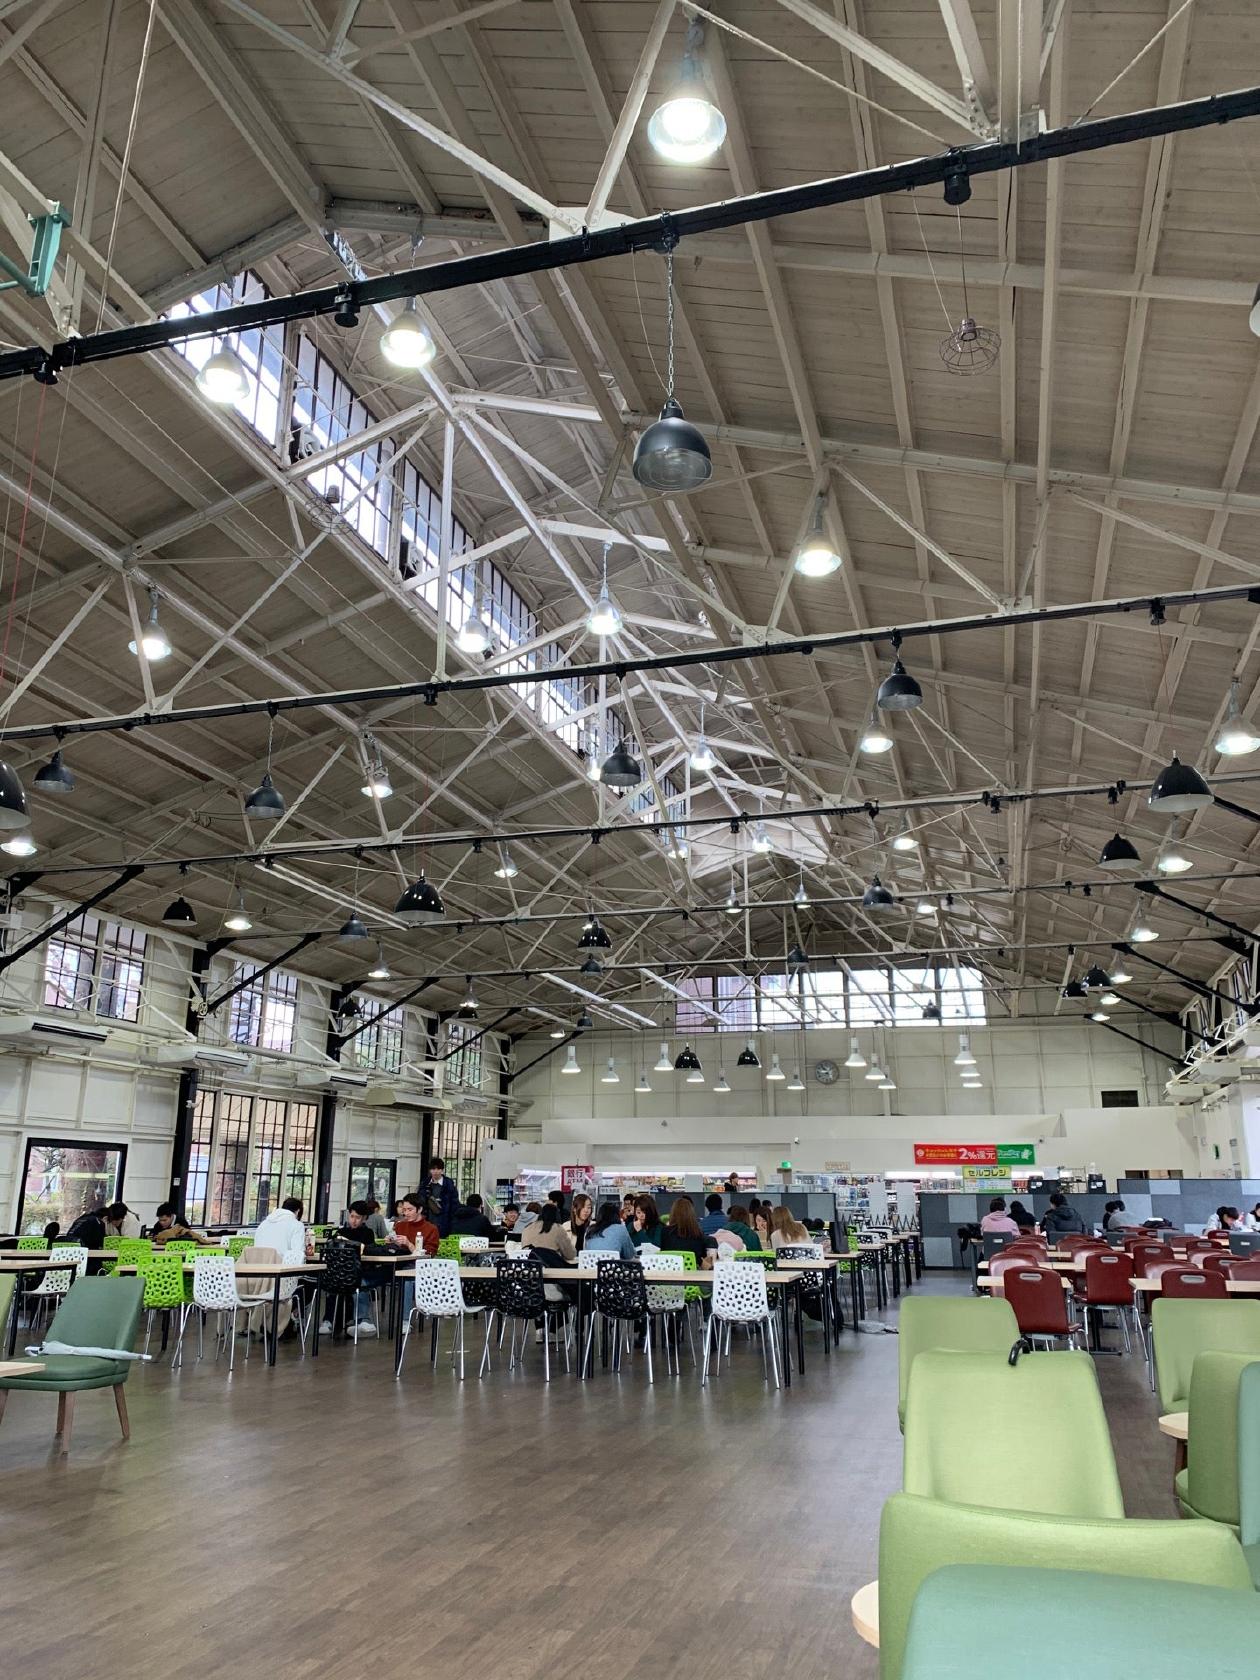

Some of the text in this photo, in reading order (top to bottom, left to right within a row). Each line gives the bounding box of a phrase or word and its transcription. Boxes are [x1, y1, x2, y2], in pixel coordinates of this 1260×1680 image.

[959, 1148, 996, 1160] 2%還元
[567, 1169, 583, 1177] 銀行
[968, 1169, 1007, 1177] セルフレジ
